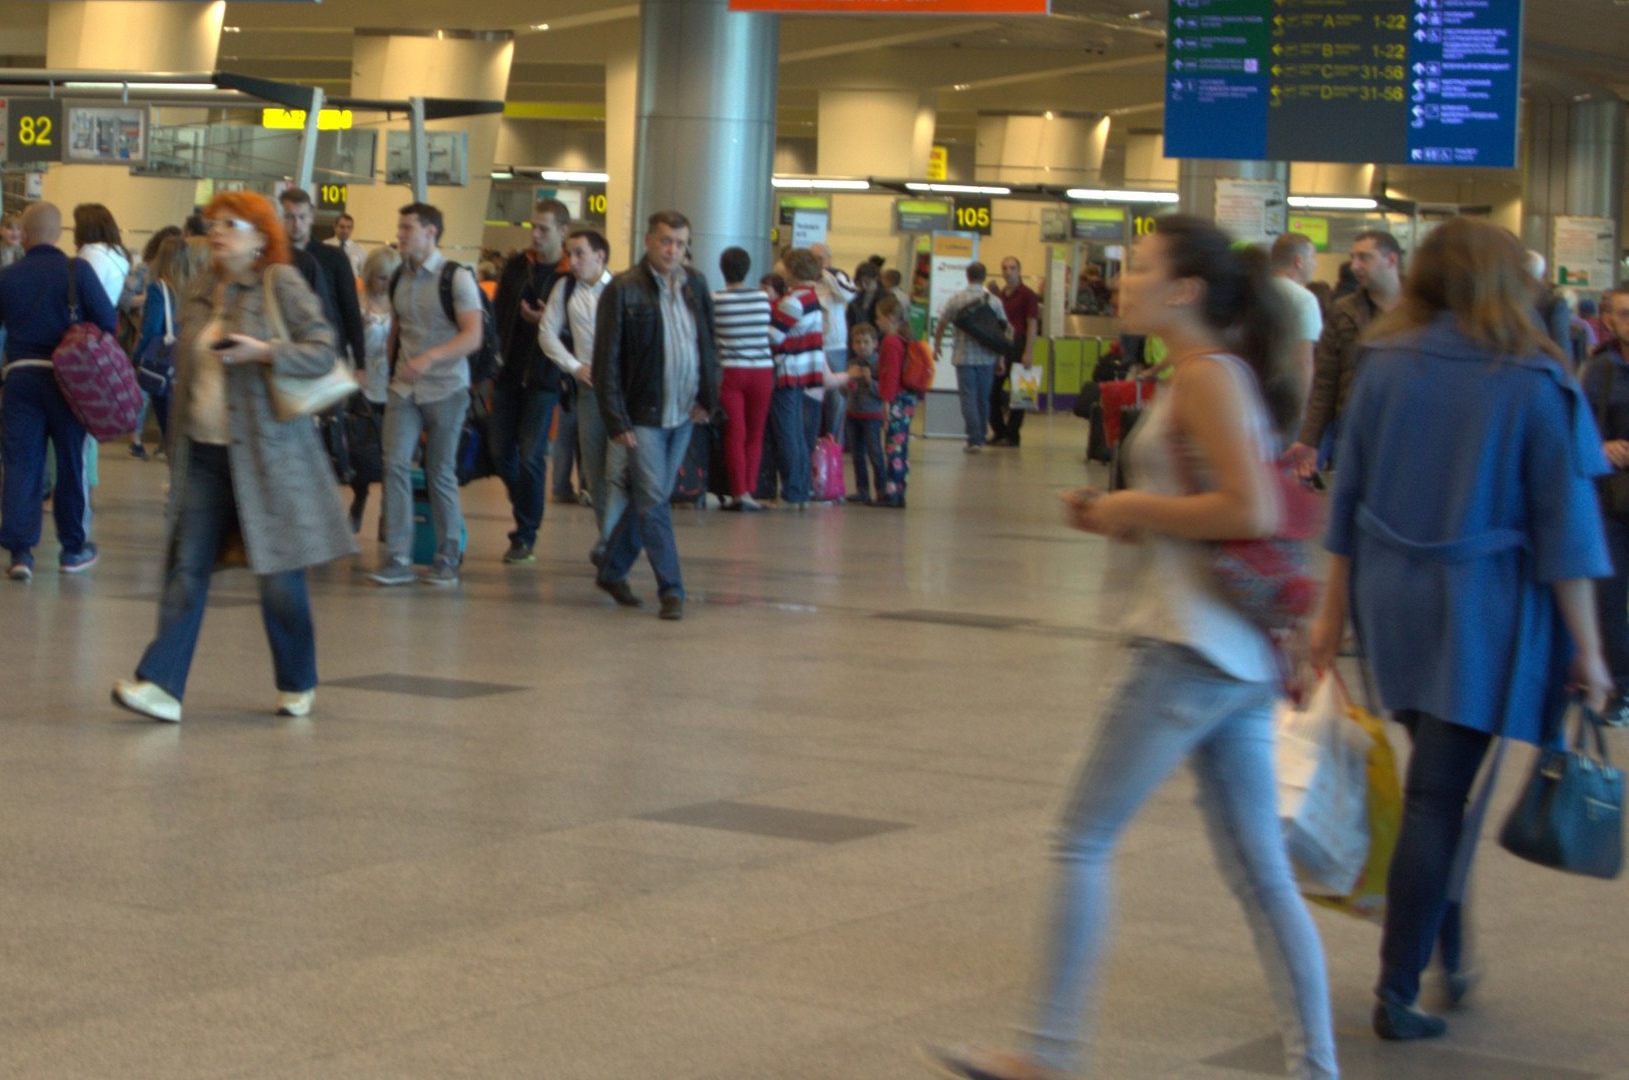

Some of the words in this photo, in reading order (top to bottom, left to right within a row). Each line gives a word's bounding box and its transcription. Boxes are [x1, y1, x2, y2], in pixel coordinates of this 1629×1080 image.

[1373, 14, 1407, 30] 1-22
[1373, 44, 1405, 59] 1-22
[19, 116, 52, 146] 82
[321, 184, 347, 203] 101
[955, 208, 990, 228] 105
